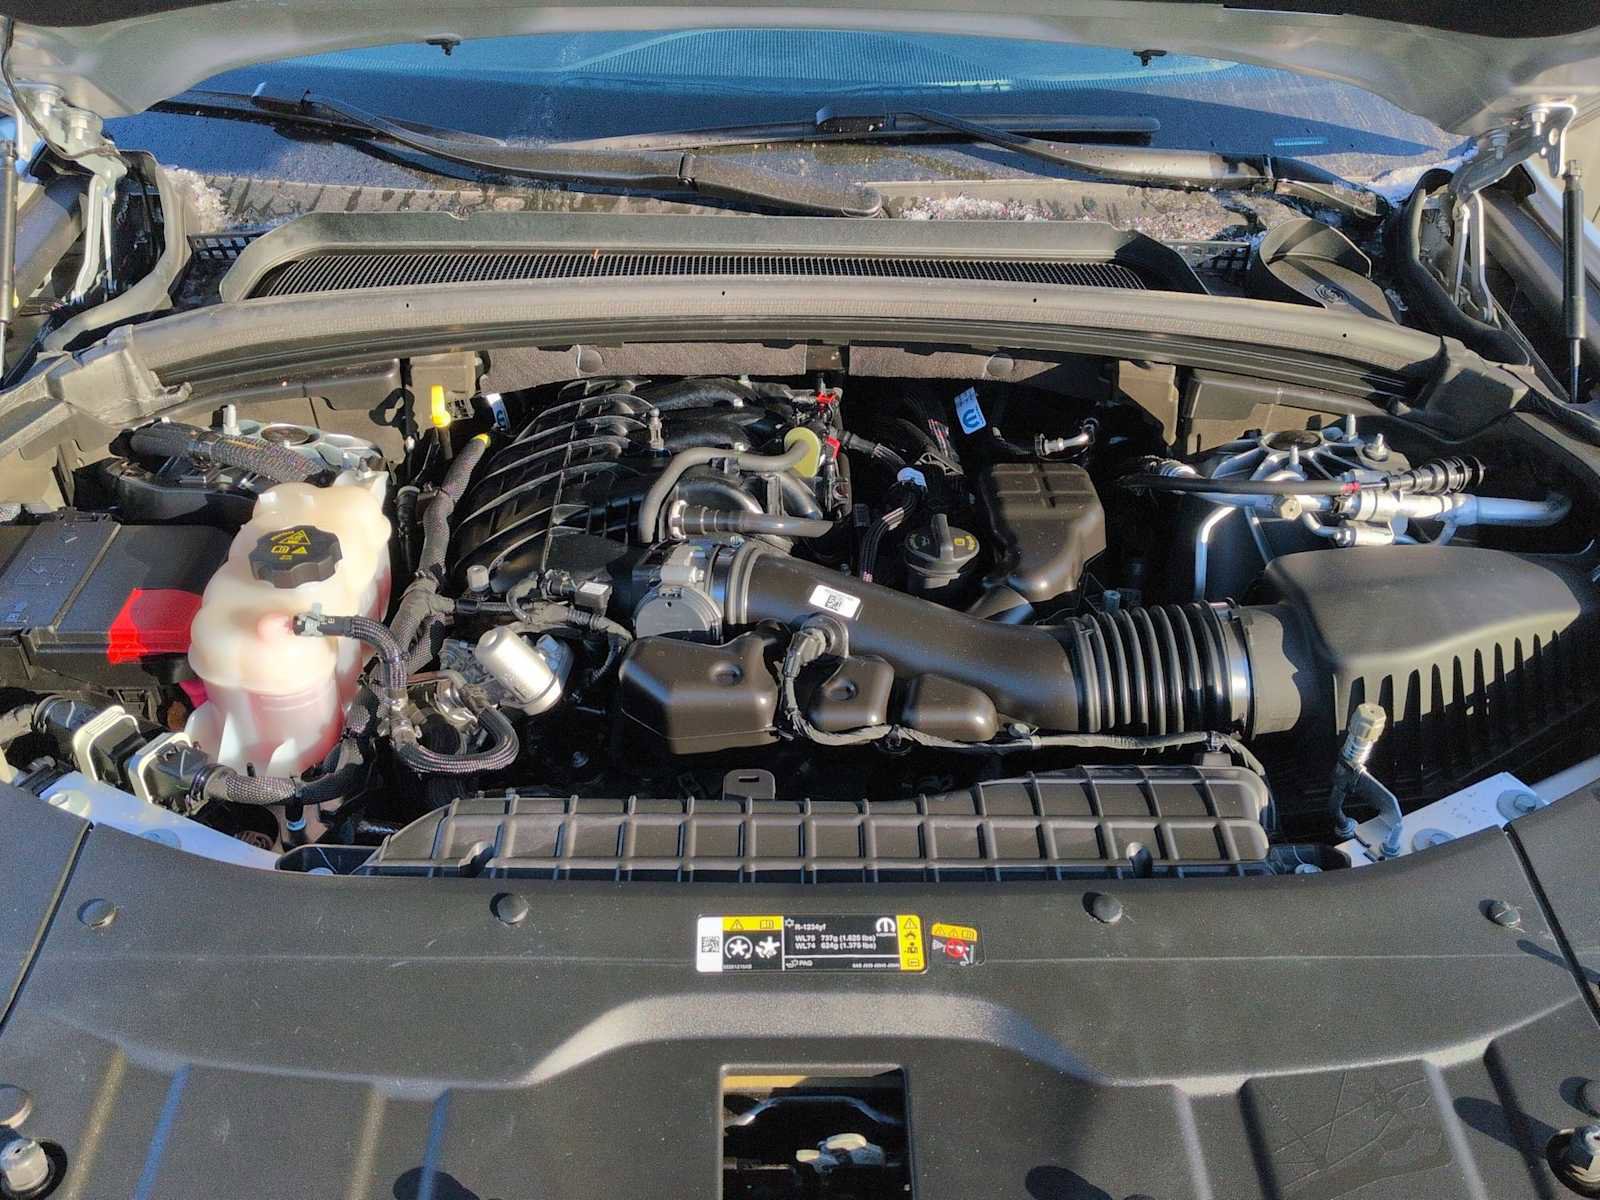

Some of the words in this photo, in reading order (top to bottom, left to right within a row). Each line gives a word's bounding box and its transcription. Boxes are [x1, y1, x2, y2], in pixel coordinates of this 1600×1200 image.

[794, 923, 827, 931] R-1234yf
[820, 934, 838, 943] 737g
[795, 942, 816, 950] WL74
